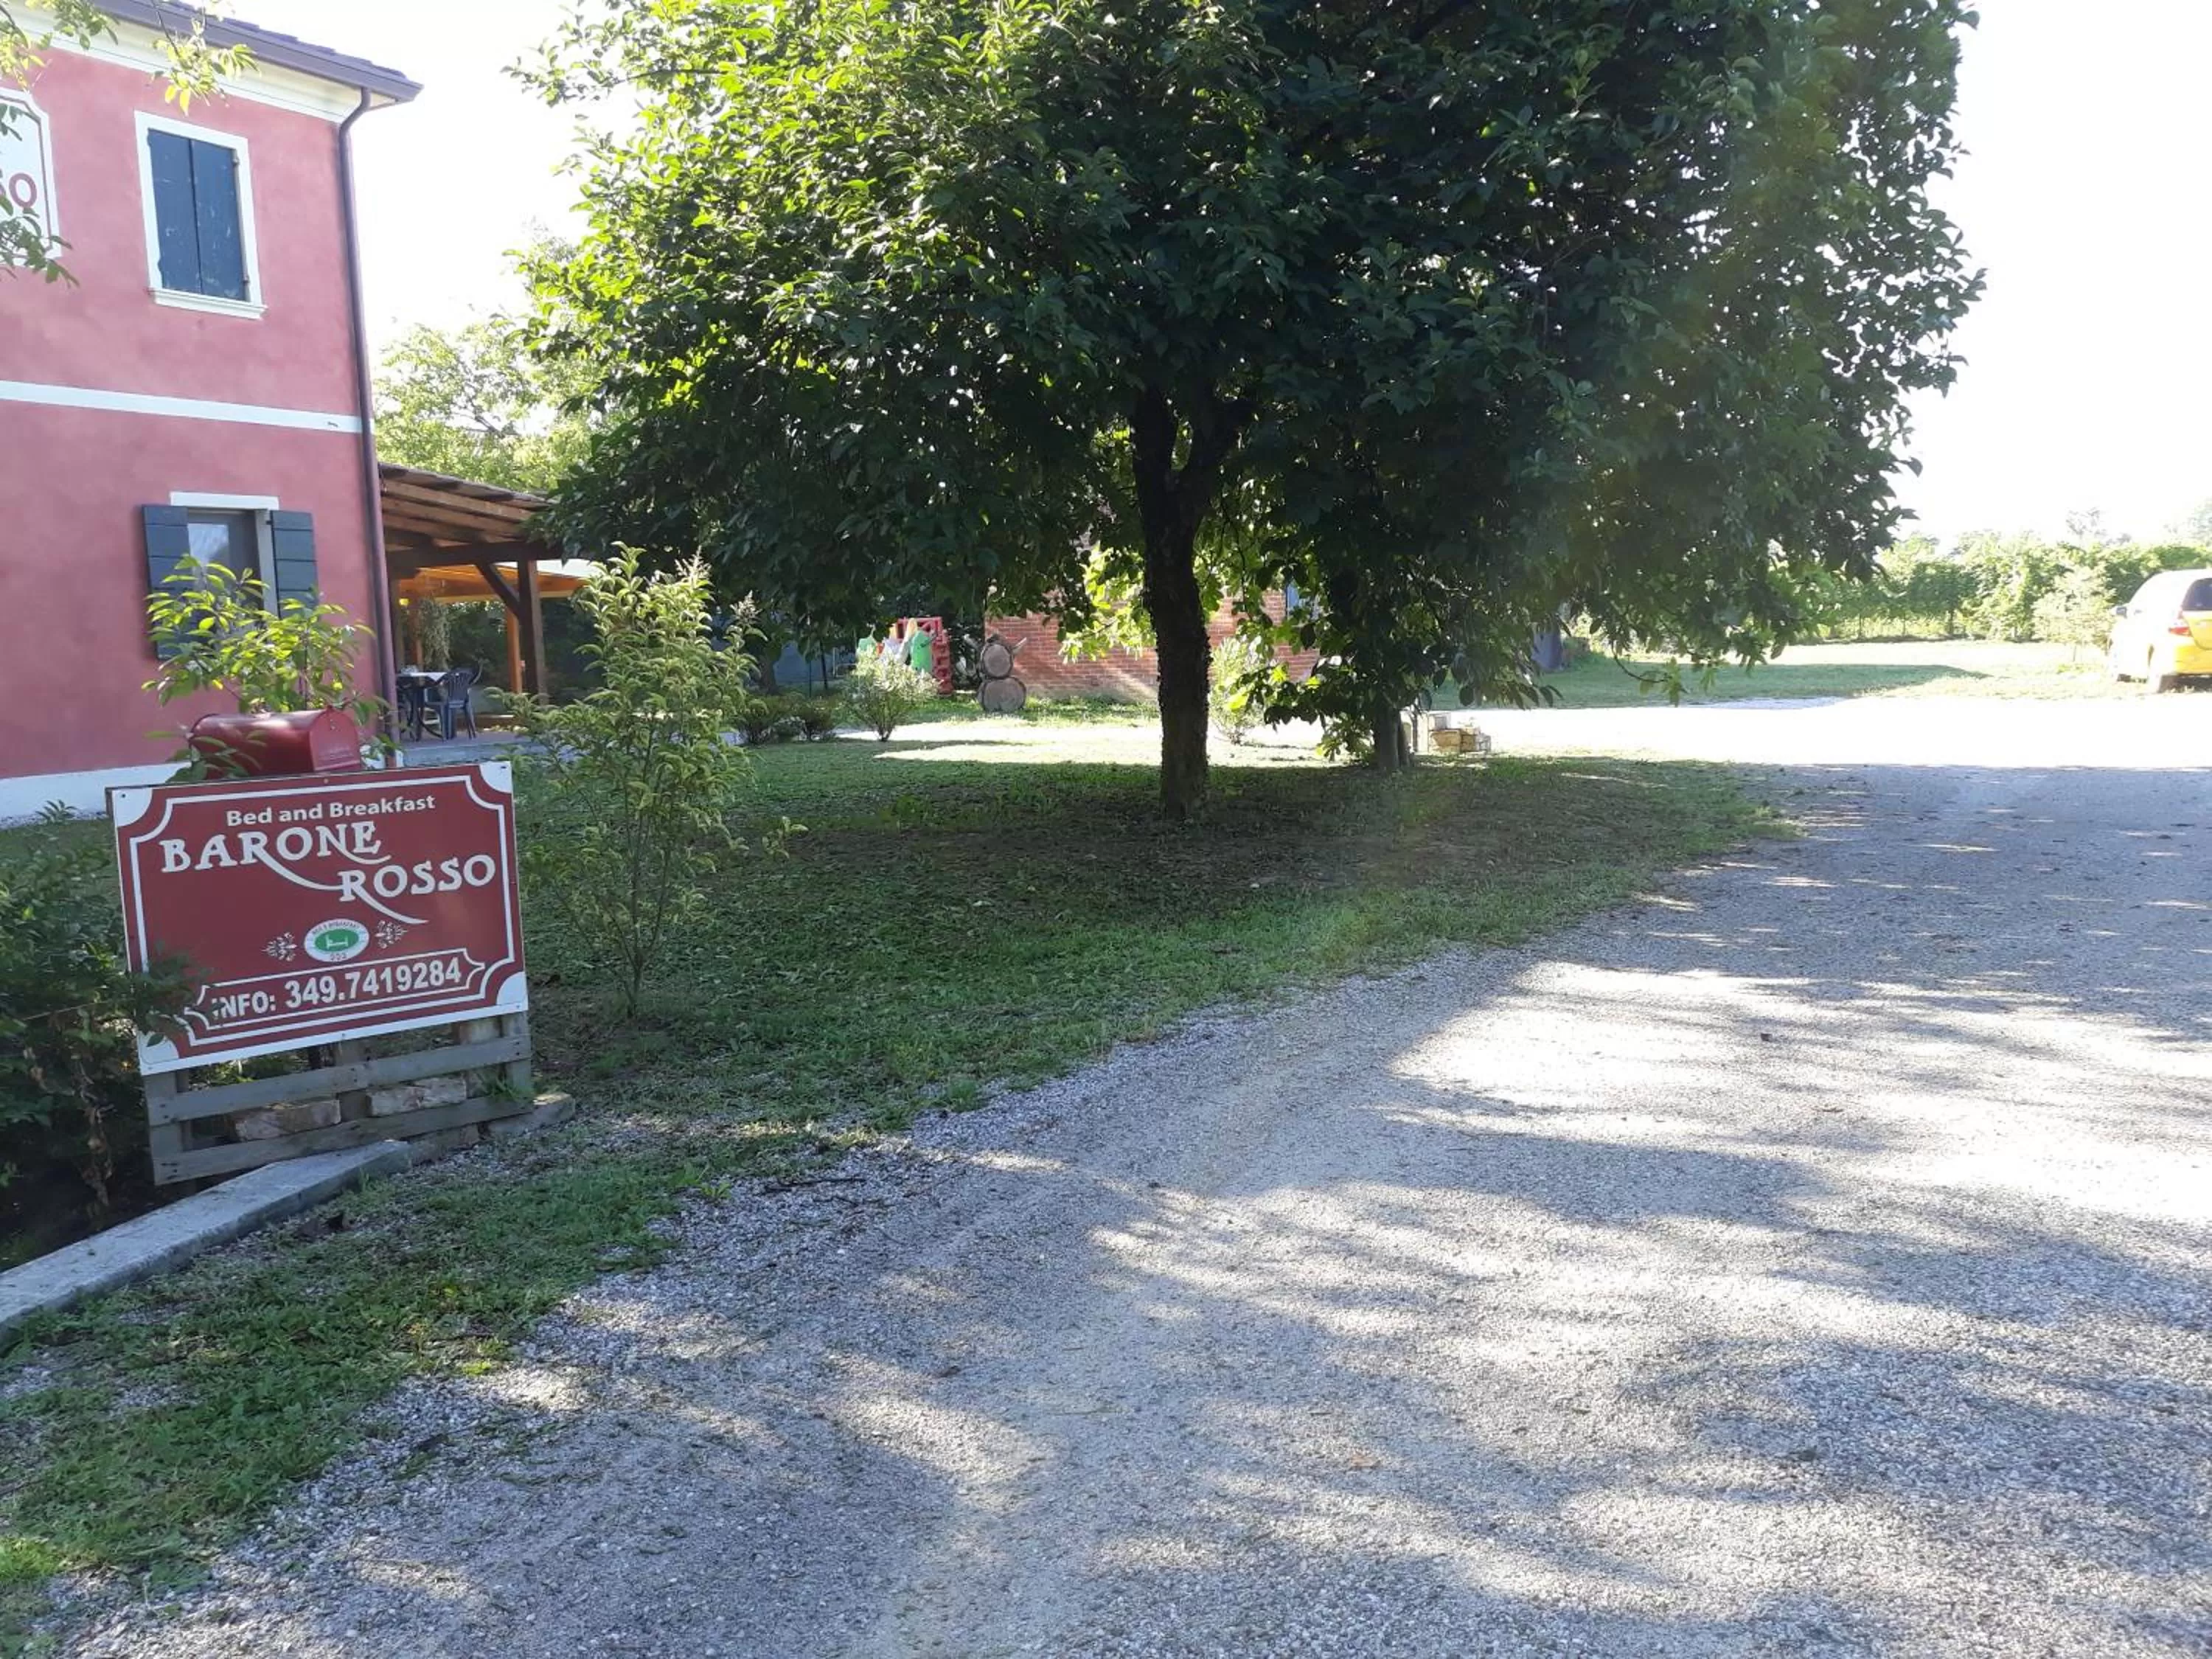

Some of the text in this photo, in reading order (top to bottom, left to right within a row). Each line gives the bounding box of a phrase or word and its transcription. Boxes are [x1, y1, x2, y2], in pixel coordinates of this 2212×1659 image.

[226, 796, 436, 827] Bed and Breakfast
[159, 821, 392, 890] BARONE
[337, 855, 496, 924] ROSSO
[285, 957, 462, 1008] 349.7419284
